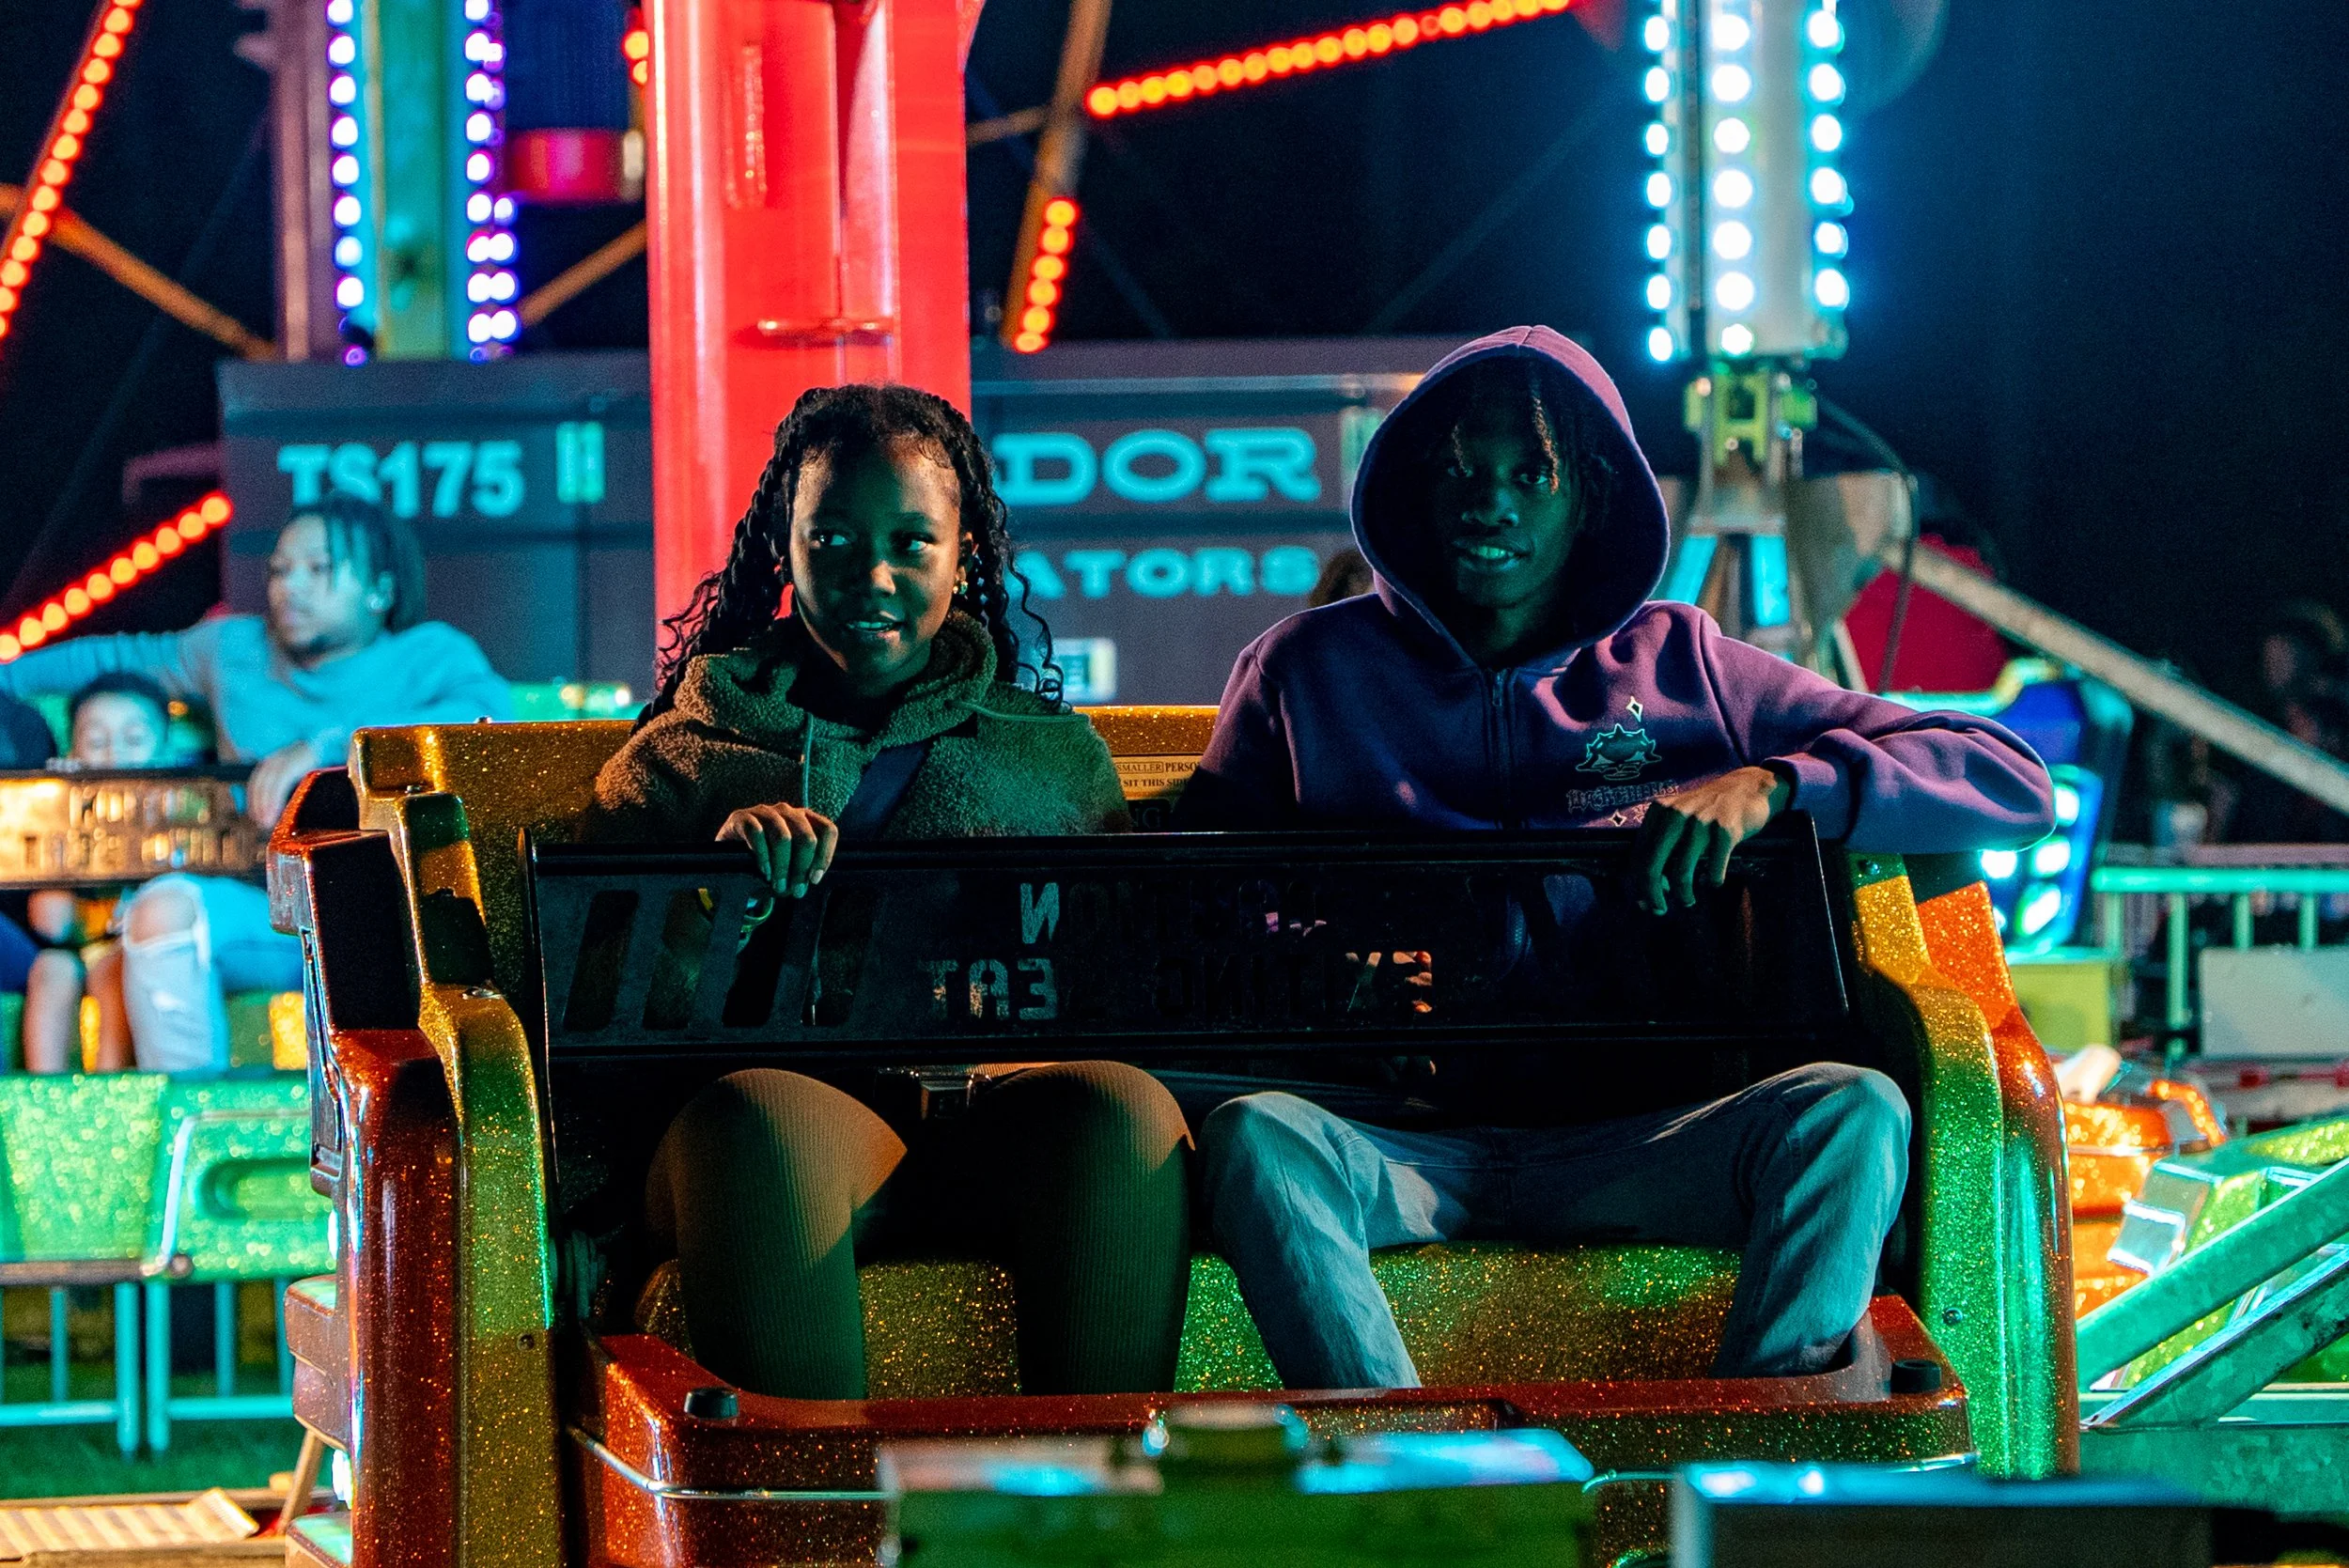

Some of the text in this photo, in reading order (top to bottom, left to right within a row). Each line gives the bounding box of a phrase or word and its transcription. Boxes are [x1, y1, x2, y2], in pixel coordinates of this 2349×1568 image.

[277, 441, 523, 518] TS175
[1116, 762, 1198, 772] SMALLER PERSO
[1124, 778, 1186, 787] SIT THIS SID
